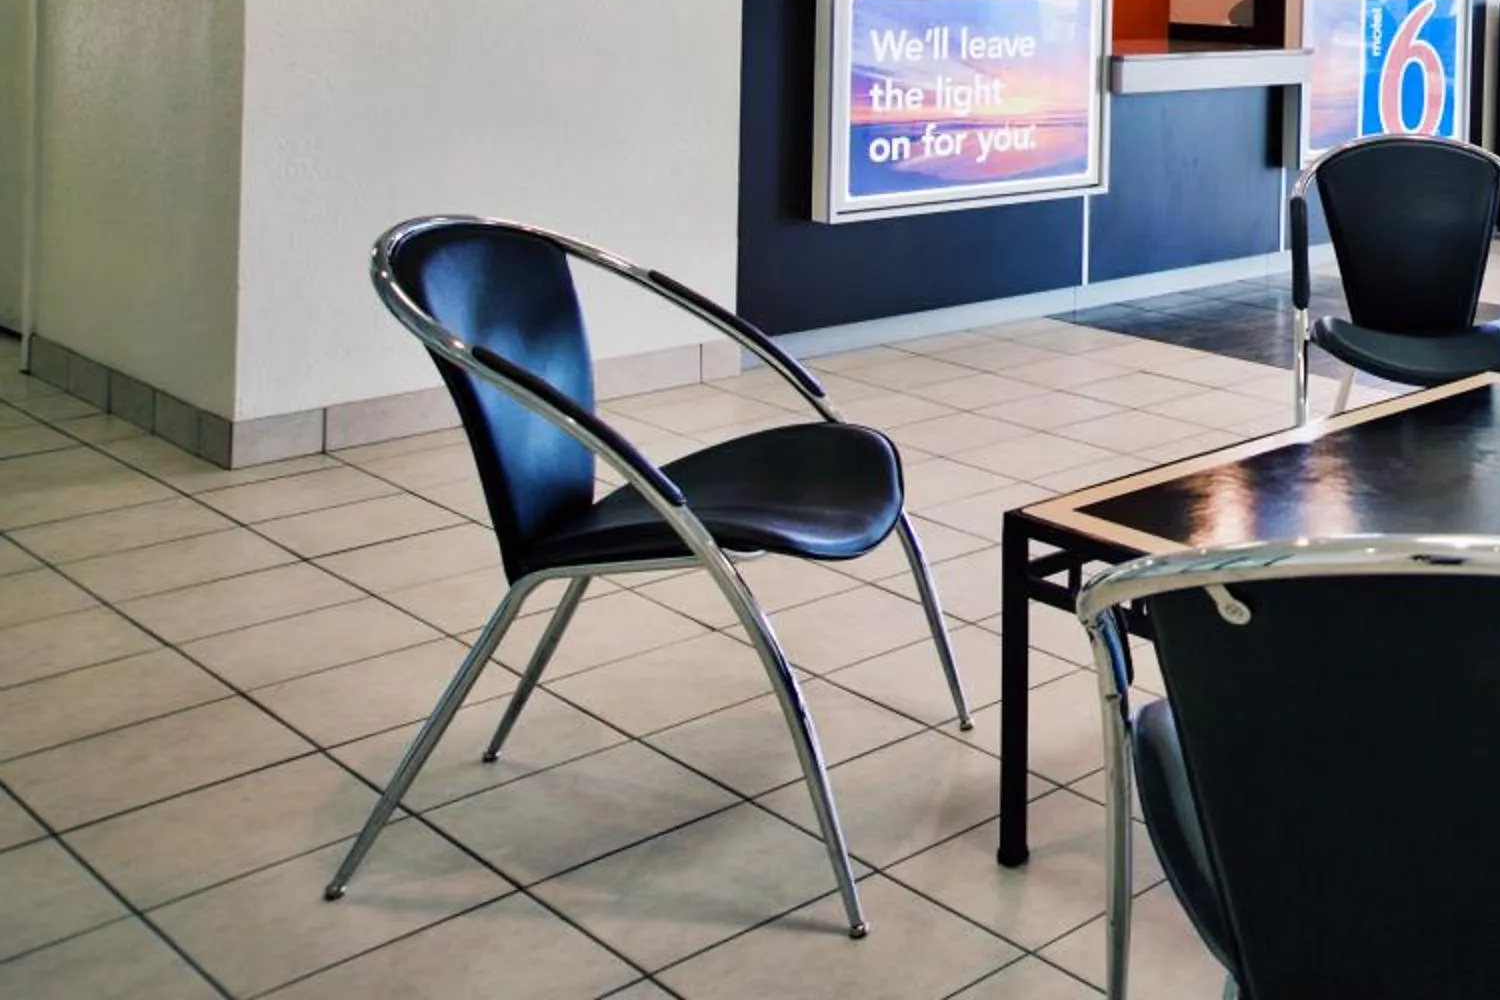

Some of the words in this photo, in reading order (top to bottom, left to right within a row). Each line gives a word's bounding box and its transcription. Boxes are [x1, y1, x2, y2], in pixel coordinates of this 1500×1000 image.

[869, 26, 949, 62] We'll
[960, 26, 1036, 60] leave
[869, 77, 924, 113] the
[936, 74, 1006, 116] light
[868, 136, 910, 163] on
[921, 122, 966, 158] for
